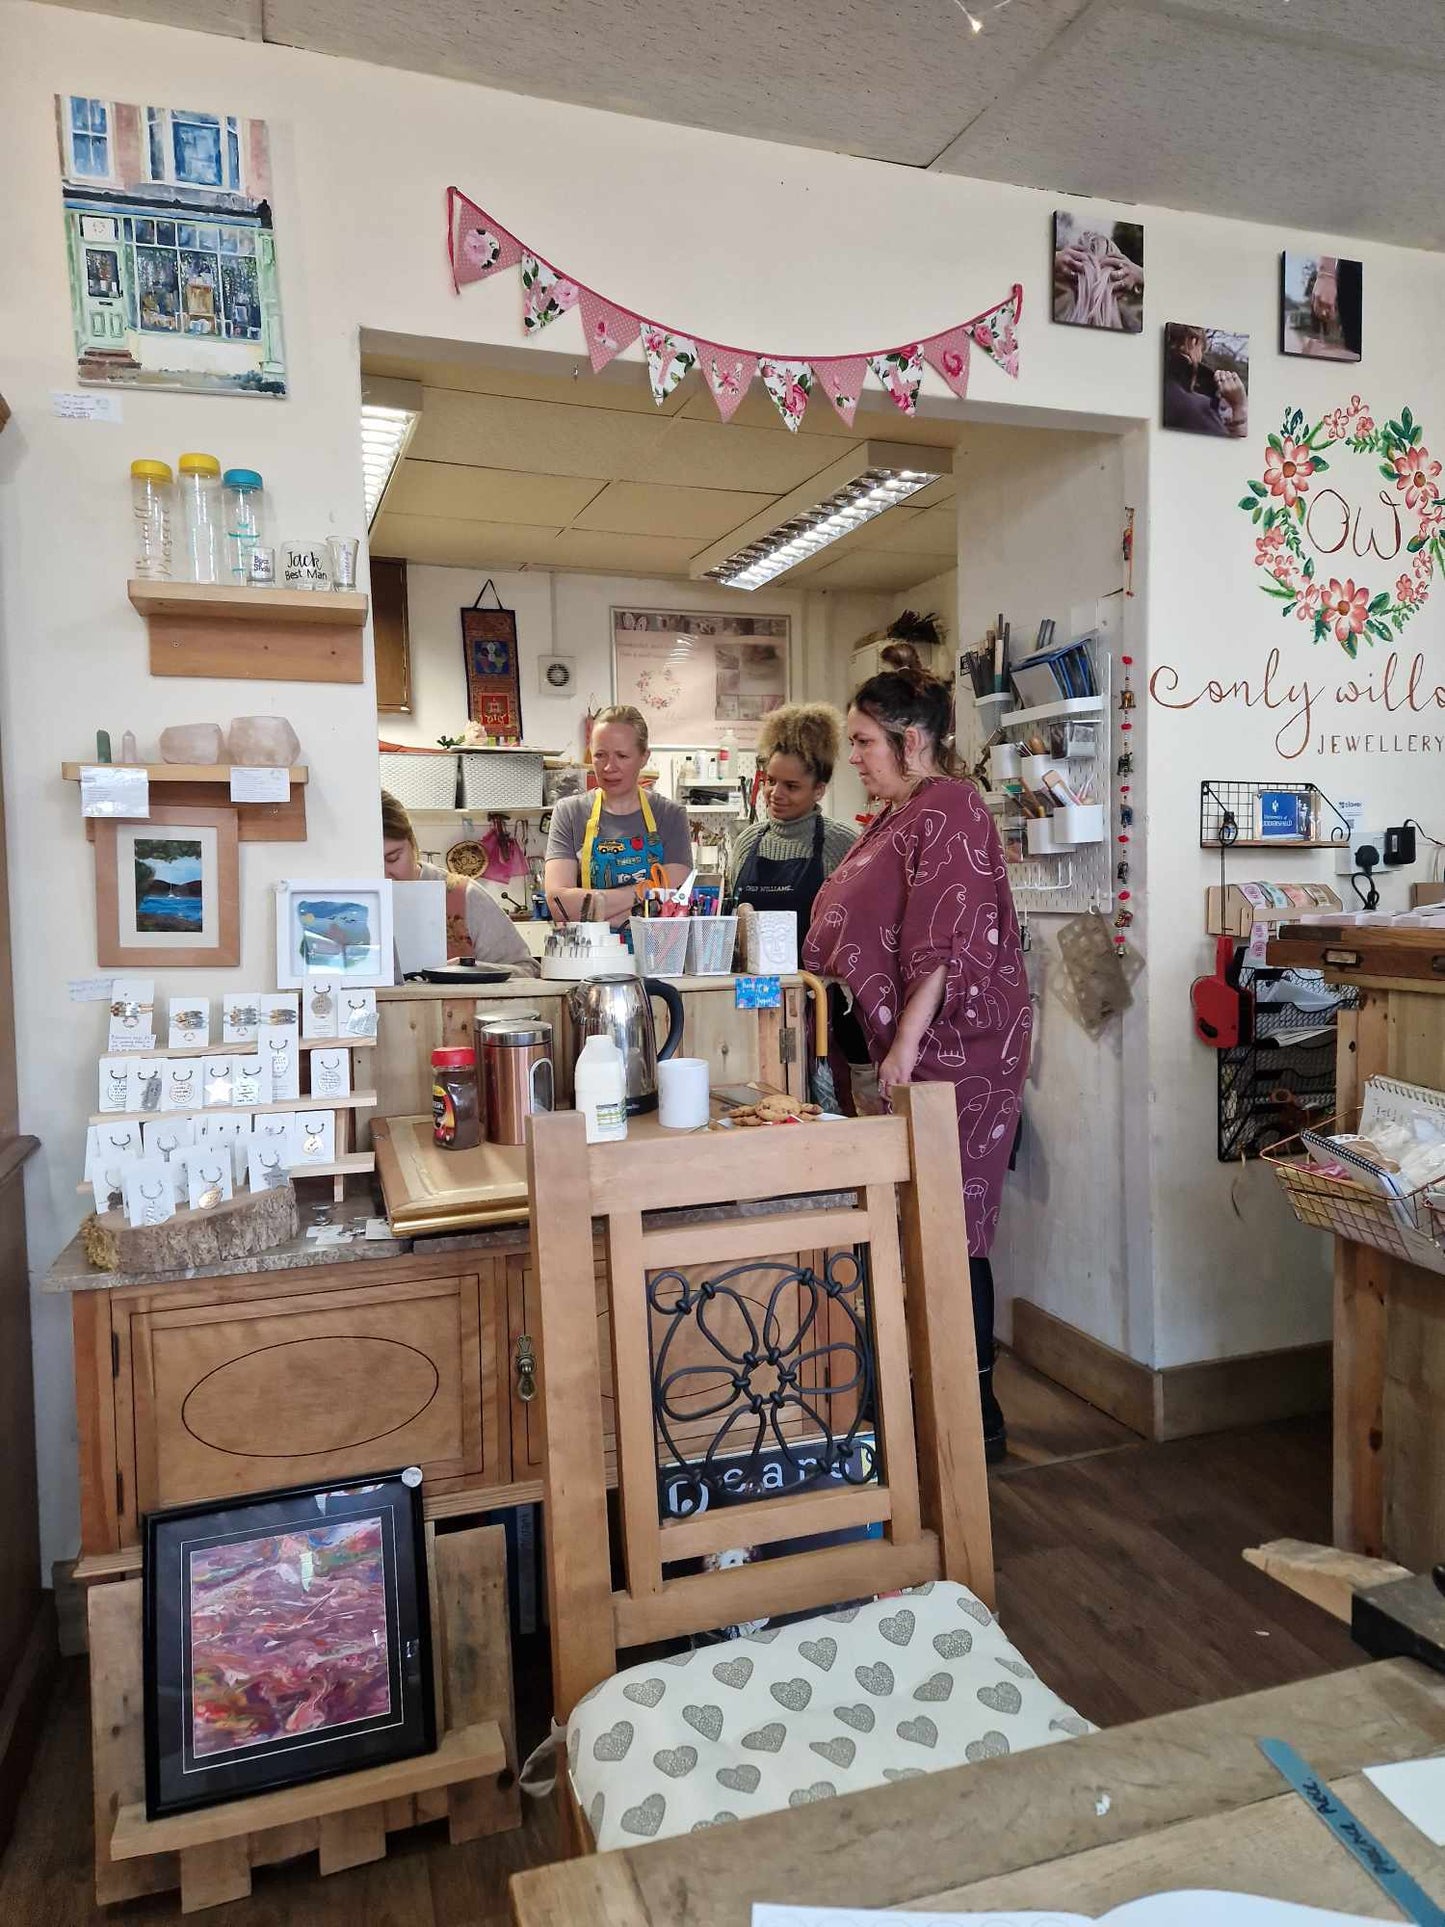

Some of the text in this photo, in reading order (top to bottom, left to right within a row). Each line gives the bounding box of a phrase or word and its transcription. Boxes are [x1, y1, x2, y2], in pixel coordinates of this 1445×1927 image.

[286, 551, 322, 570] Jack
[284, 569, 328, 580] Best Man
[1317, 734, 1445, 755] JEWELLERY
